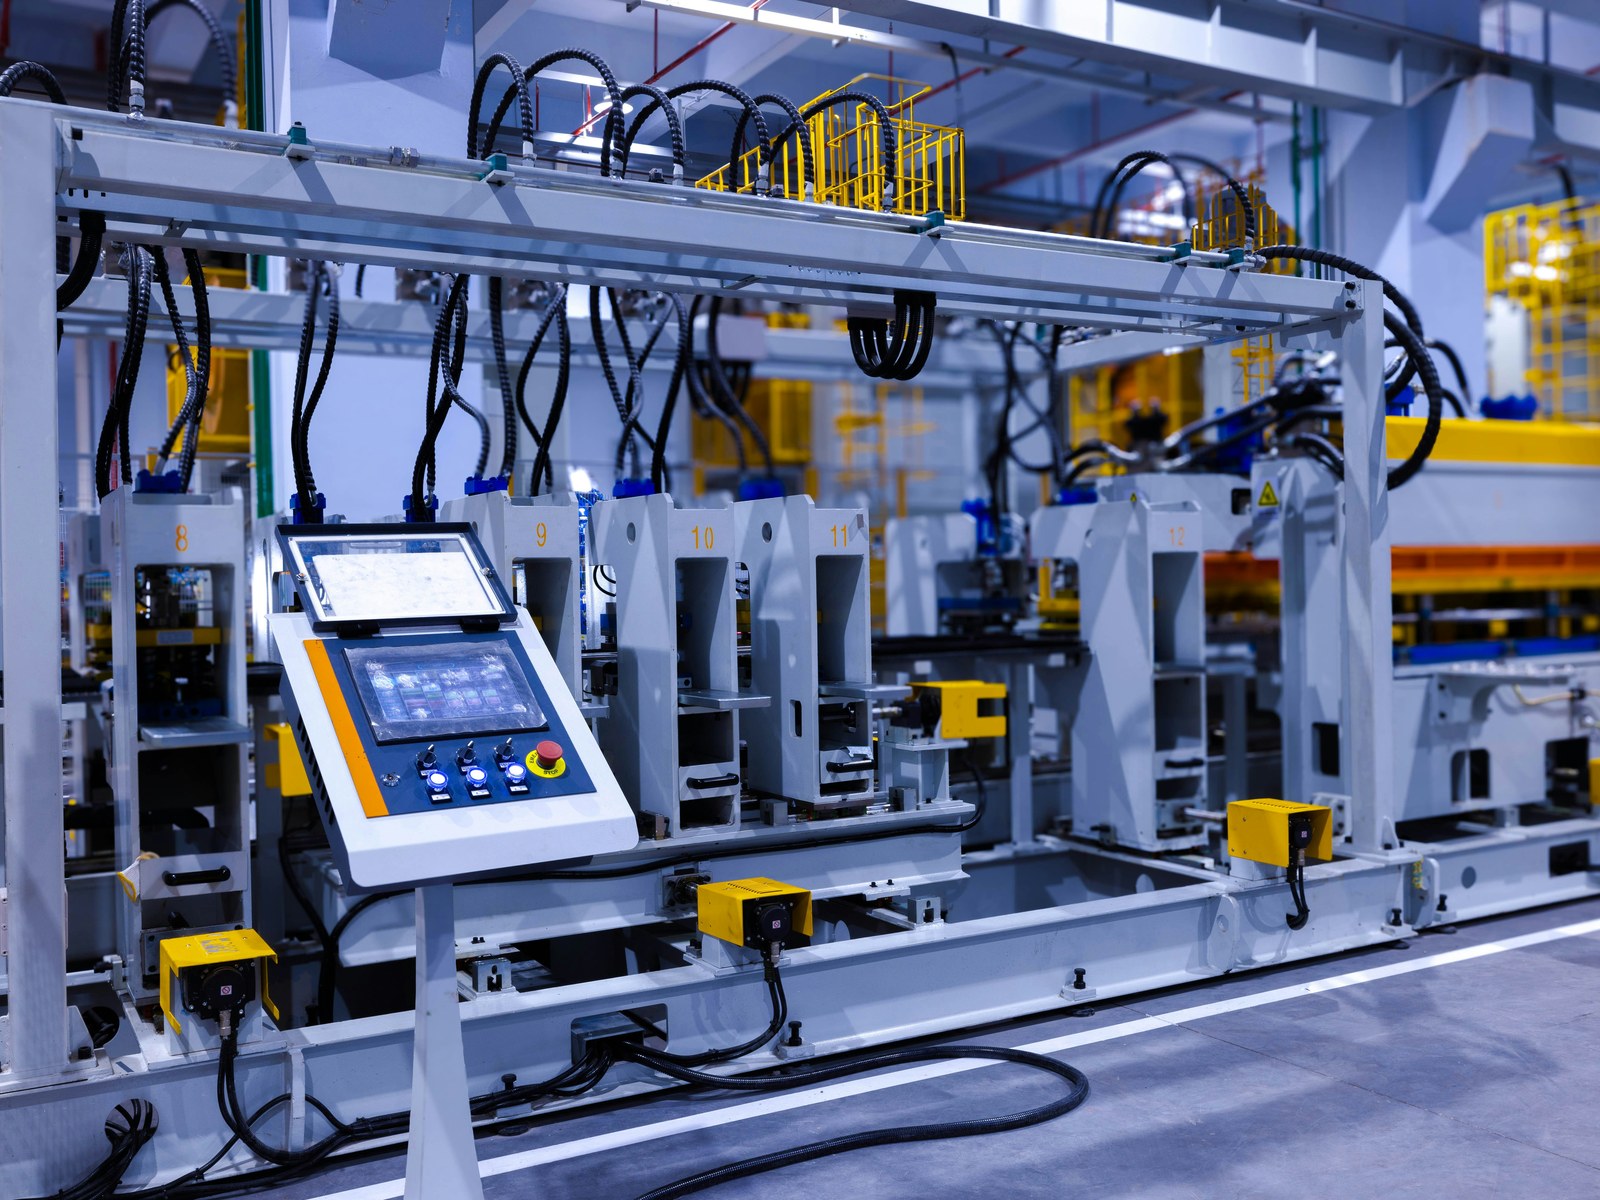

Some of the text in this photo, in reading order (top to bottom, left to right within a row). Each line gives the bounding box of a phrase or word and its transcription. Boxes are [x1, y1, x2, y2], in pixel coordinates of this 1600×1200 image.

[176, 524, 188, 552] 8
[536, 522, 547, 547] 9
[691, 525, 714, 549] 10
[830, 524, 847, 547] 11
[1169, 527, 1185, 546] 12
